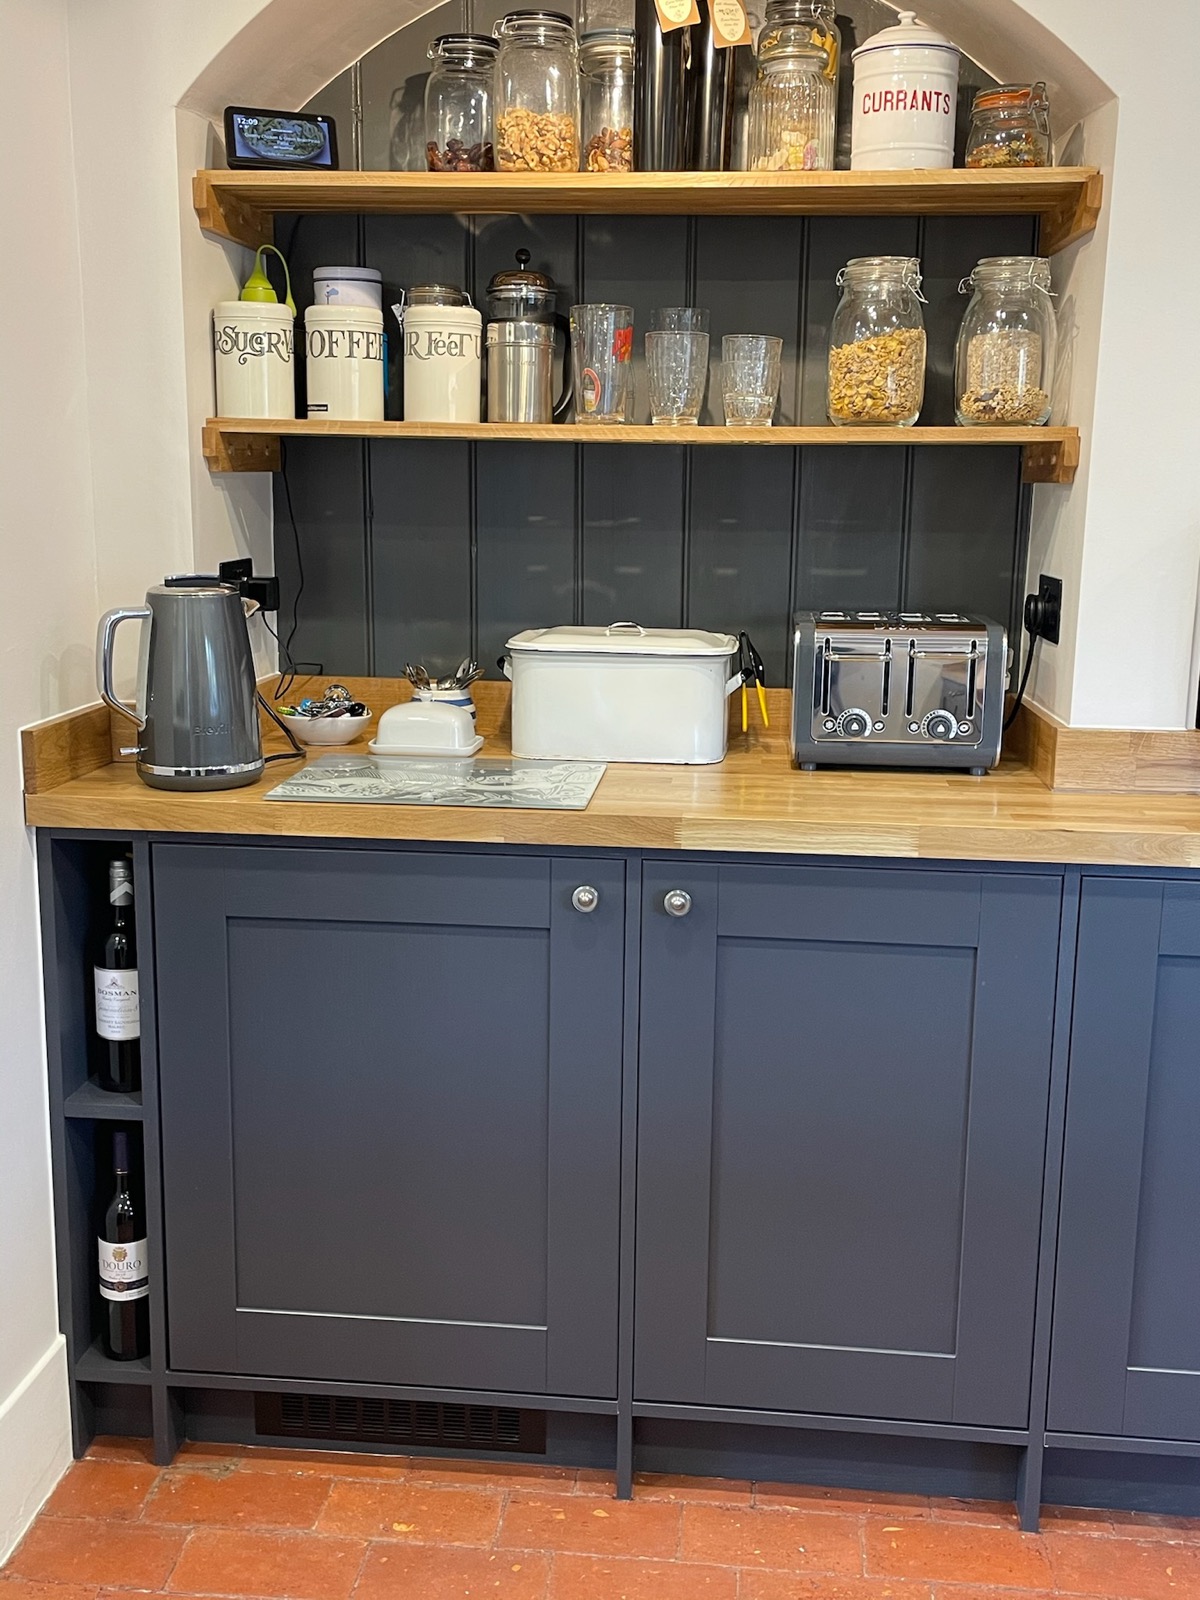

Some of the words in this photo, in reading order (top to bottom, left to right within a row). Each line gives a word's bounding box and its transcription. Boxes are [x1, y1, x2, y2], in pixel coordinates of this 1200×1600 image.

[862, 89, 951, 115] CURRANTS
[237, 117, 258, 126] 12:09
[97, 987, 137, 996] BOSMAN
[102, 1259, 141, 1269] DOURO
